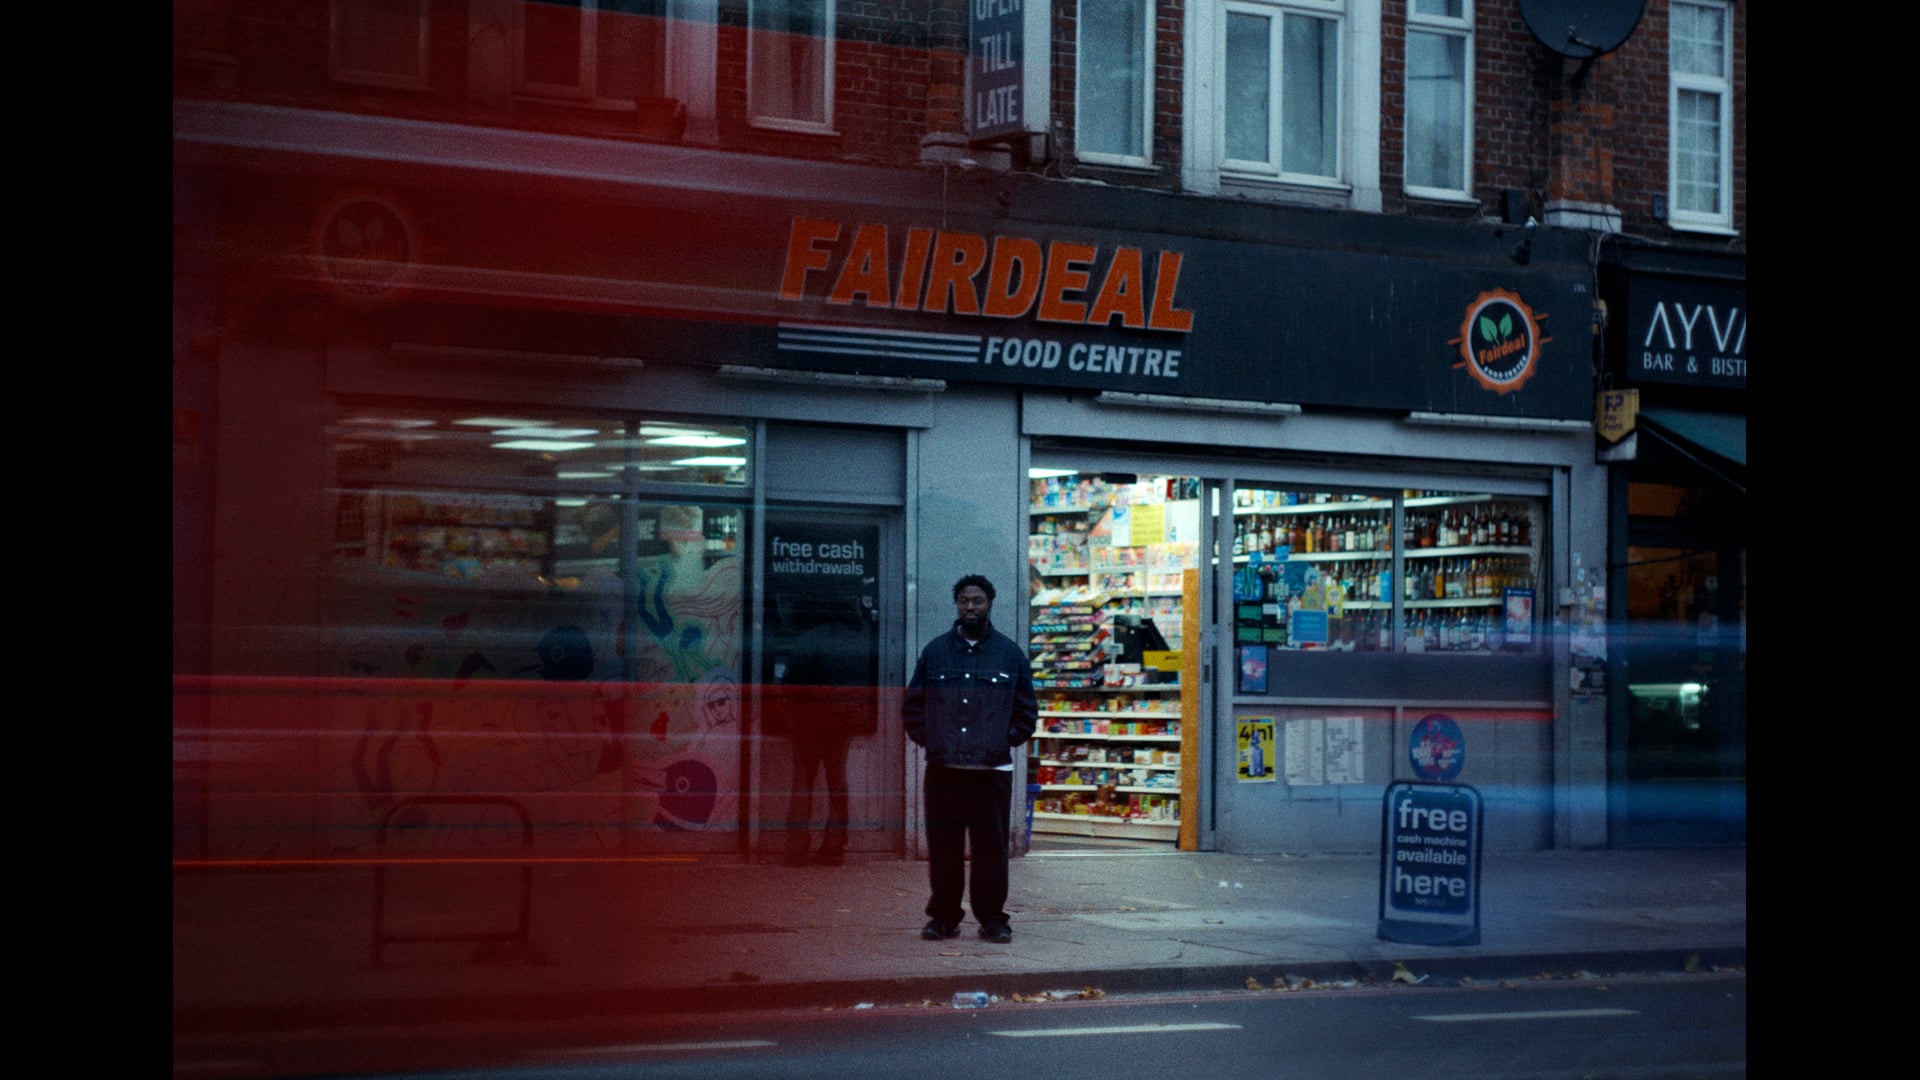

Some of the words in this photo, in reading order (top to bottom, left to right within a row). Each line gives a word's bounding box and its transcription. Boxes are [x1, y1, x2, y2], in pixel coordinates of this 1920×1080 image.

[979, 31, 1016, 74] TILL
[977, 84, 1018, 129] LATE
[779, 218, 1194, 332] FAIRDEAL
[983, 337, 1067, 369] FOOD
[1069, 343, 1182, 378] CENTRE
[1478, 333, 1526, 365] Fairdeal
[1643, 351, 1674, 372] BAR
[1686, 354, 1699, 374] &
[772, 536, 813, 558] free
[819, 540, 864, 560] cash
[772, 558, 864, 576] withdrawals
[1399, 799, 1468, 832] free
[1396, 834, 1422, 845] cash
[1424, 835, 1467, 848] machine
[1396, 848, 1467, 866] available
[1394, 866, 1467, 898] here
